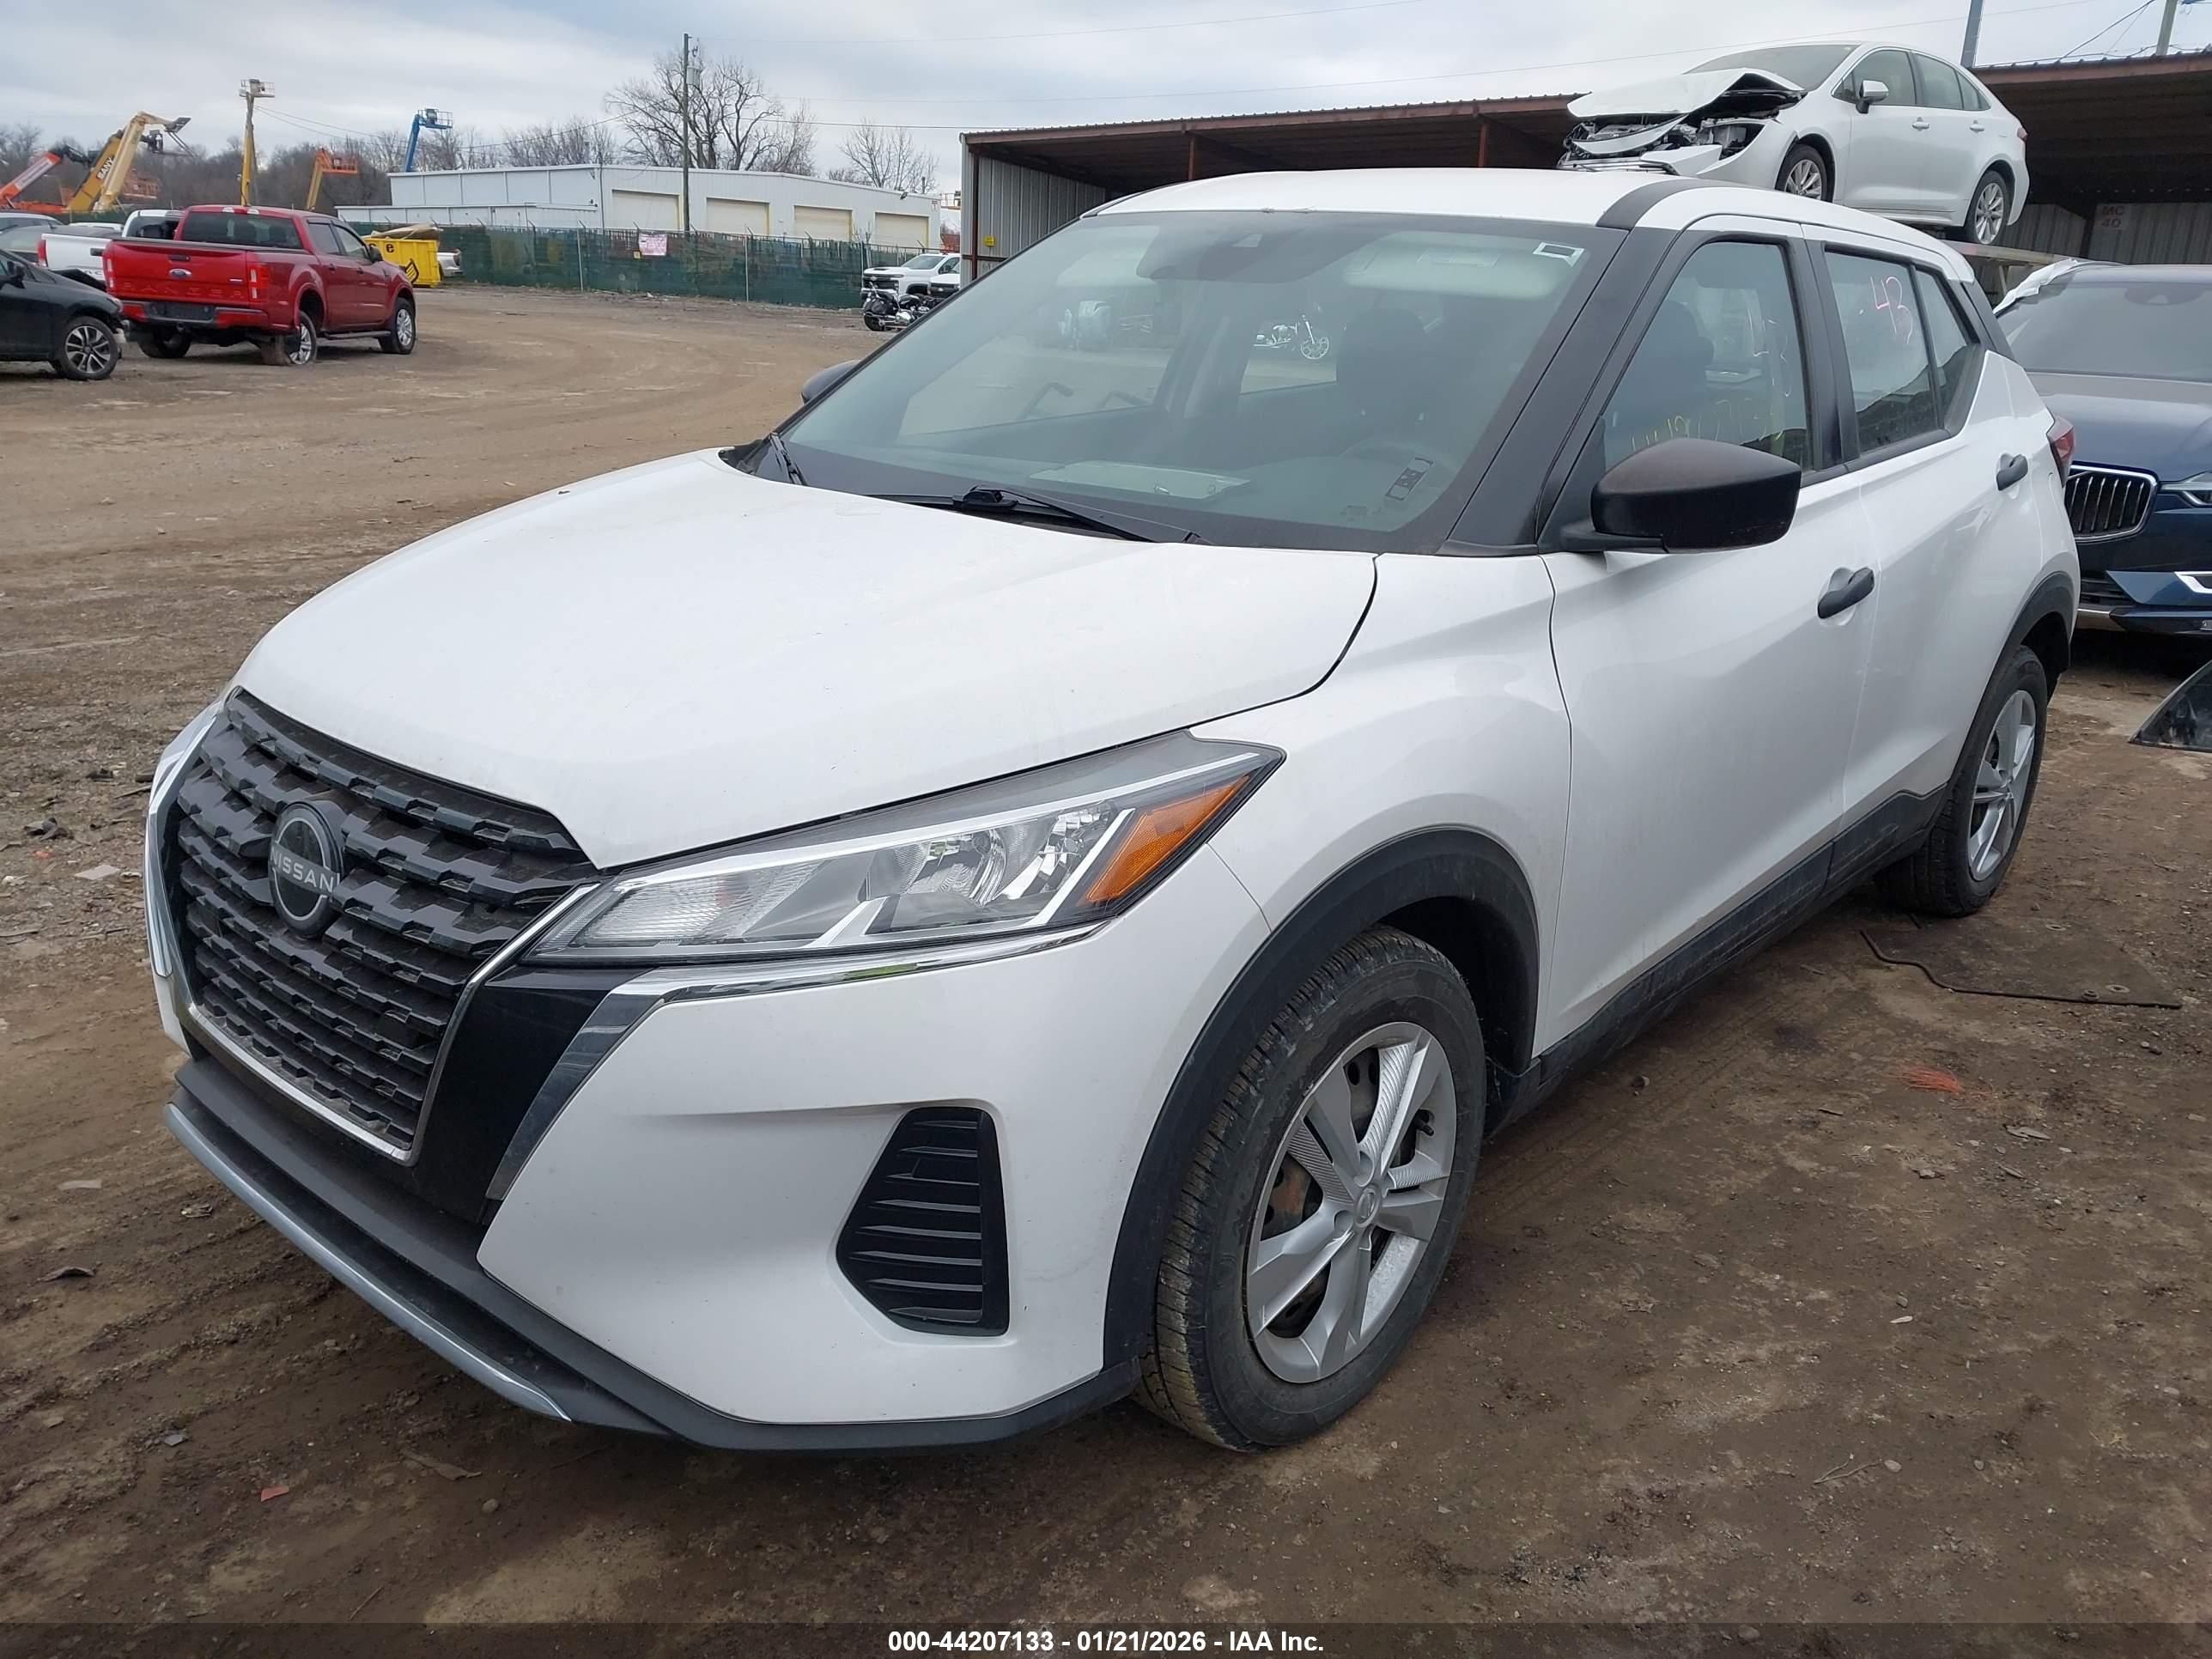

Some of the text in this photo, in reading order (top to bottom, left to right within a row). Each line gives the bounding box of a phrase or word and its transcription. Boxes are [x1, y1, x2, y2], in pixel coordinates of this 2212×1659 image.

[96, 155, 114, 179] SANY
[2101, 205, 2125, 216] MC
[2101, 217, 2122, 228] 40
[270, 847, 335, 894] NISSAN
